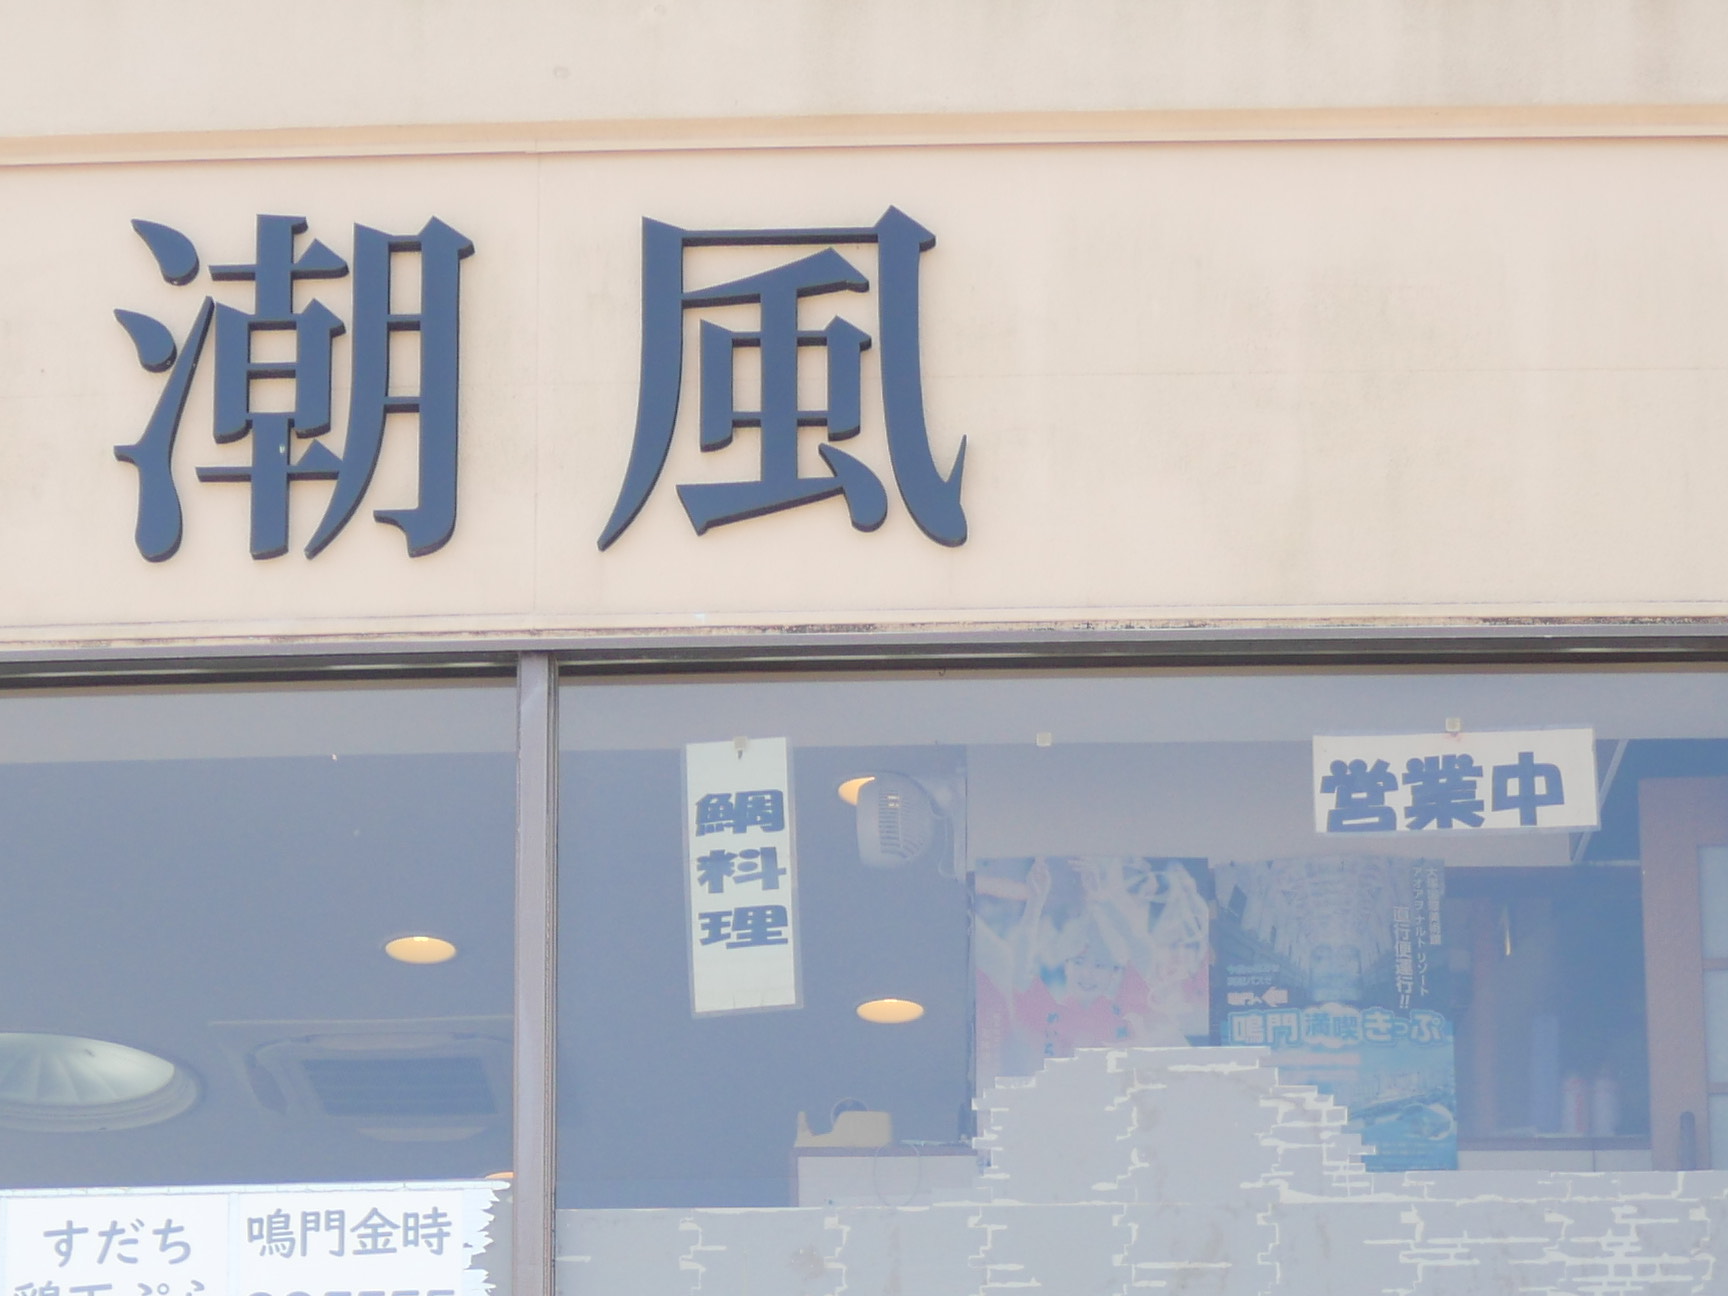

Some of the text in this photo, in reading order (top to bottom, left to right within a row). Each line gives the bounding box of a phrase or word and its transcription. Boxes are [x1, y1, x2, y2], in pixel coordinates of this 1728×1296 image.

[113, 204, 969, 563] 潮風
[1319, 750, 1566, 833] 営業中
[696, 788, 789, 952] 鯛料理
[43, 1217, 193, 1268] すだち
[246, 1207, 453, 1259] 鳴門金時
